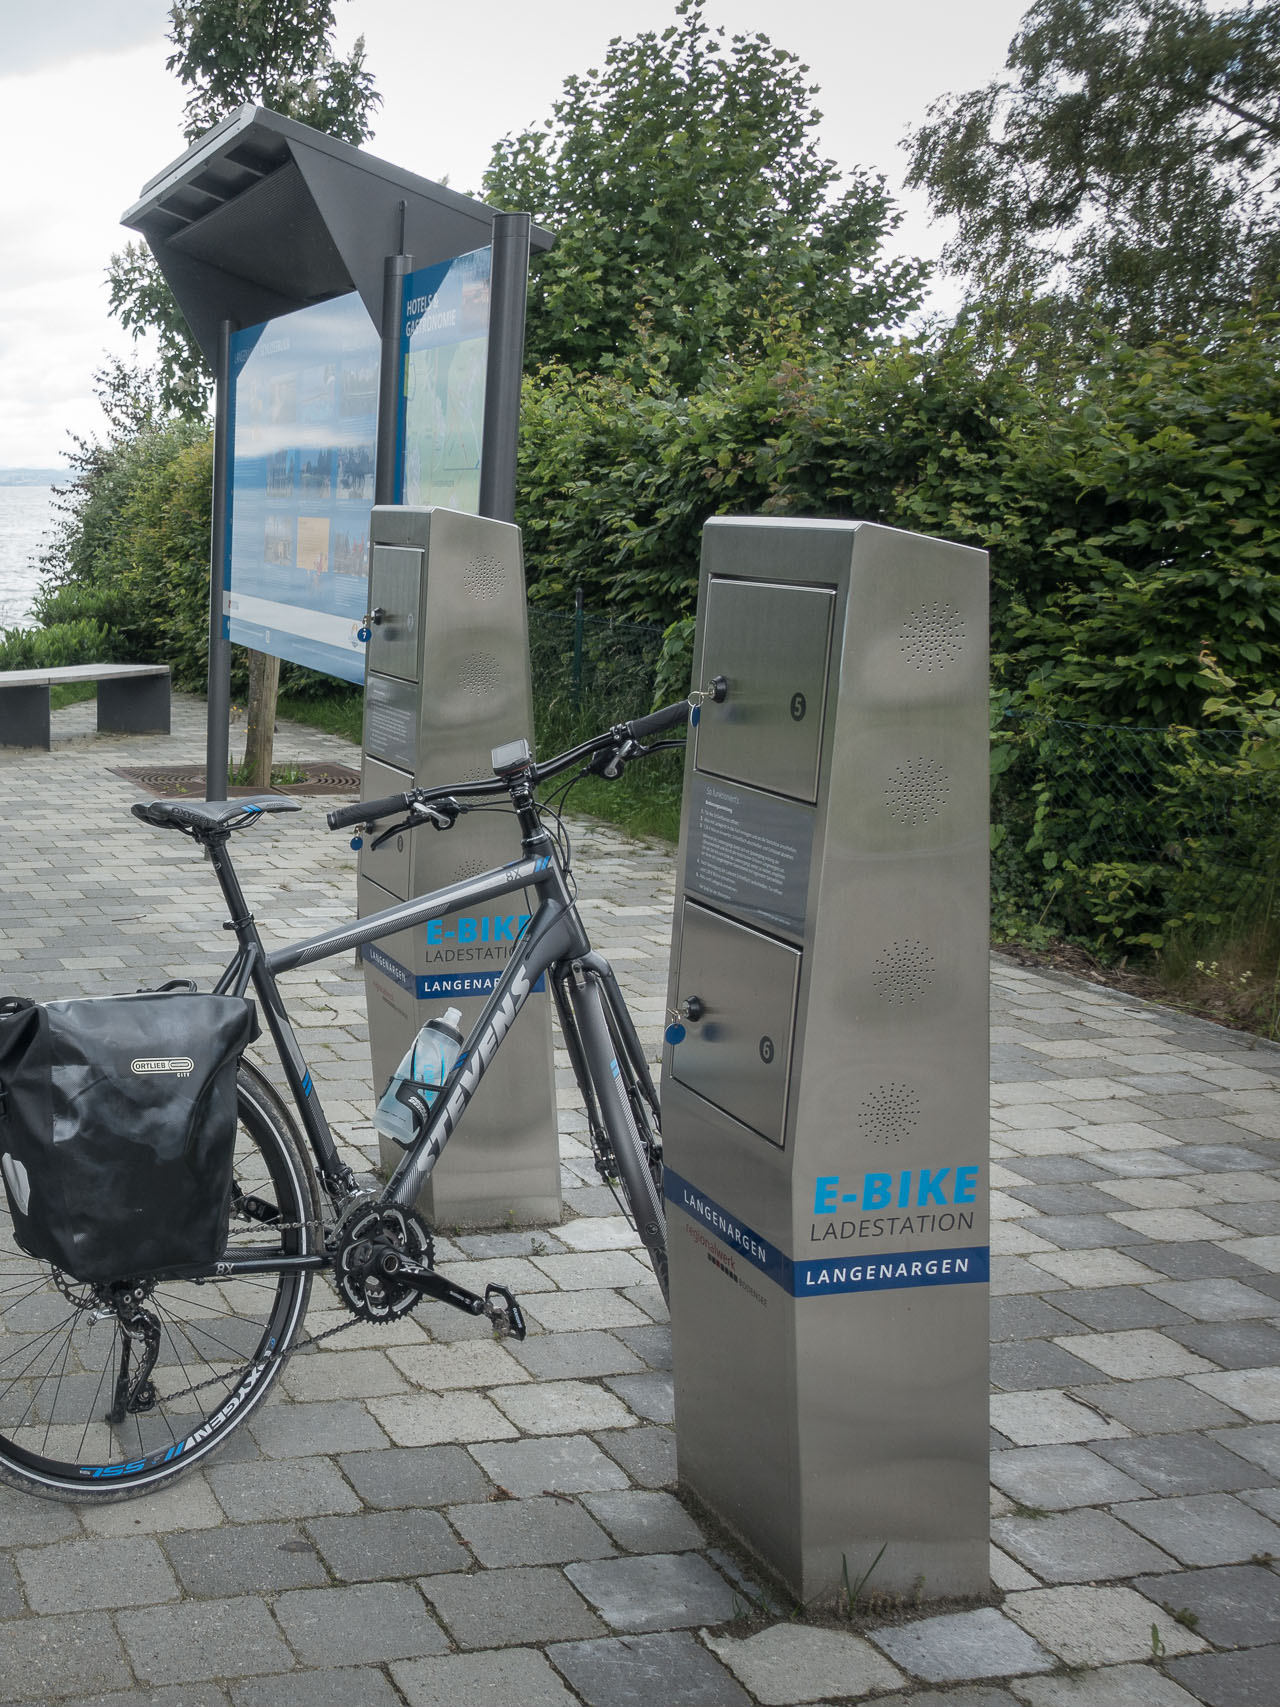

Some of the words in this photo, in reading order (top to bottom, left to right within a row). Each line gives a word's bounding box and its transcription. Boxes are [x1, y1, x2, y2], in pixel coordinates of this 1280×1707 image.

[406, 294, 432, 317] HOTELS
[405, 309, 457, 337] GASTRONOMIE
[505, 868, 522, 882] 8X
[425, 946, 513, 963] LADESTATI
[424, 977, 501, 992] LANGENA
[135, 1061, 166, 1070] ORTLIEB
[417, 963, 533, 1172] STEVENS
[813, 1165, 980, 1215] E-BIKE
[683, 1189, 766, 1263] LANGENARGEN
[810, 1211, 975, 1242] LADESTATION
[215, 1262, 235, 1276] 8X
[806, 1257, 970, 1285] LANGENARGEN
[80, 1457, 147, 1478] SSL
